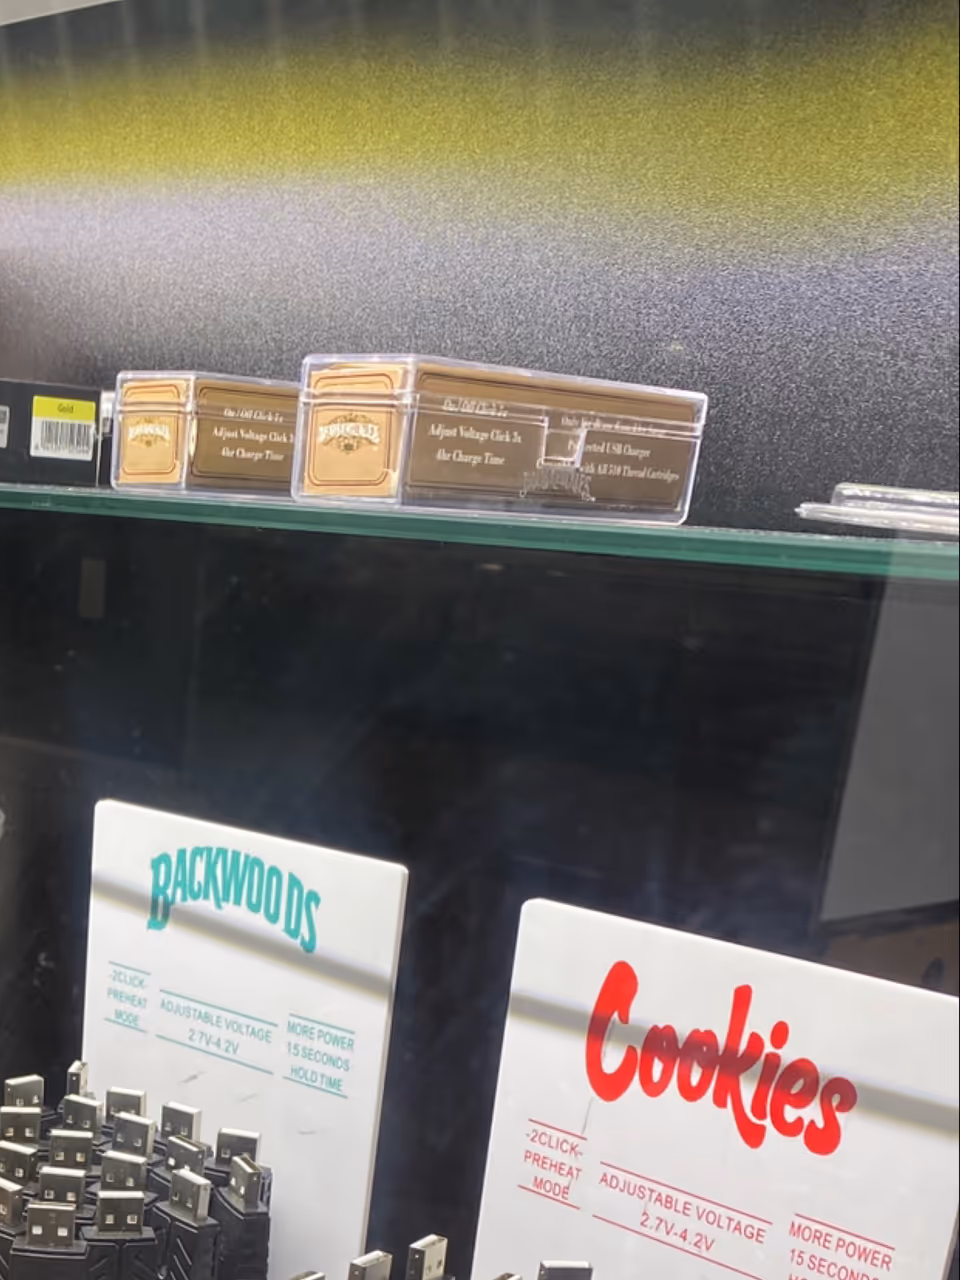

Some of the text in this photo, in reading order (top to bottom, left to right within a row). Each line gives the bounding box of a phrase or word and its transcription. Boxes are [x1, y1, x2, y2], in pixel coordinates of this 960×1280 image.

[57, 403, 74, 414] Gold
[147, 845, 321, 954] BACKWOODS
[107, 987, 147, 1010] PREHEAT
[114, 1008, 139, 1029] MODE
[159, 998, 273, 1044] ADJUSTABLE VOLTAGE
[287, 1020, 354, 1051] MORE POWER
[287, 1040, 351, 1072] 15 SECONDS
[585, 960, 858, 1156] Cookies
[290, 1063, 344, 1091] HOLD TIME
[524, 1149, 582, 1182] PREHEAT
[533, 1175, 570, 1201] MODE
[599, 1172, 766, 1245] ADJUSTABLE VOLTAGE
[640, 1211, 716, 1253] 2.7V-4.2V
[789, 1220, 893, 1273] MORE POWER
[790, 1248, 806, 1267] 15
